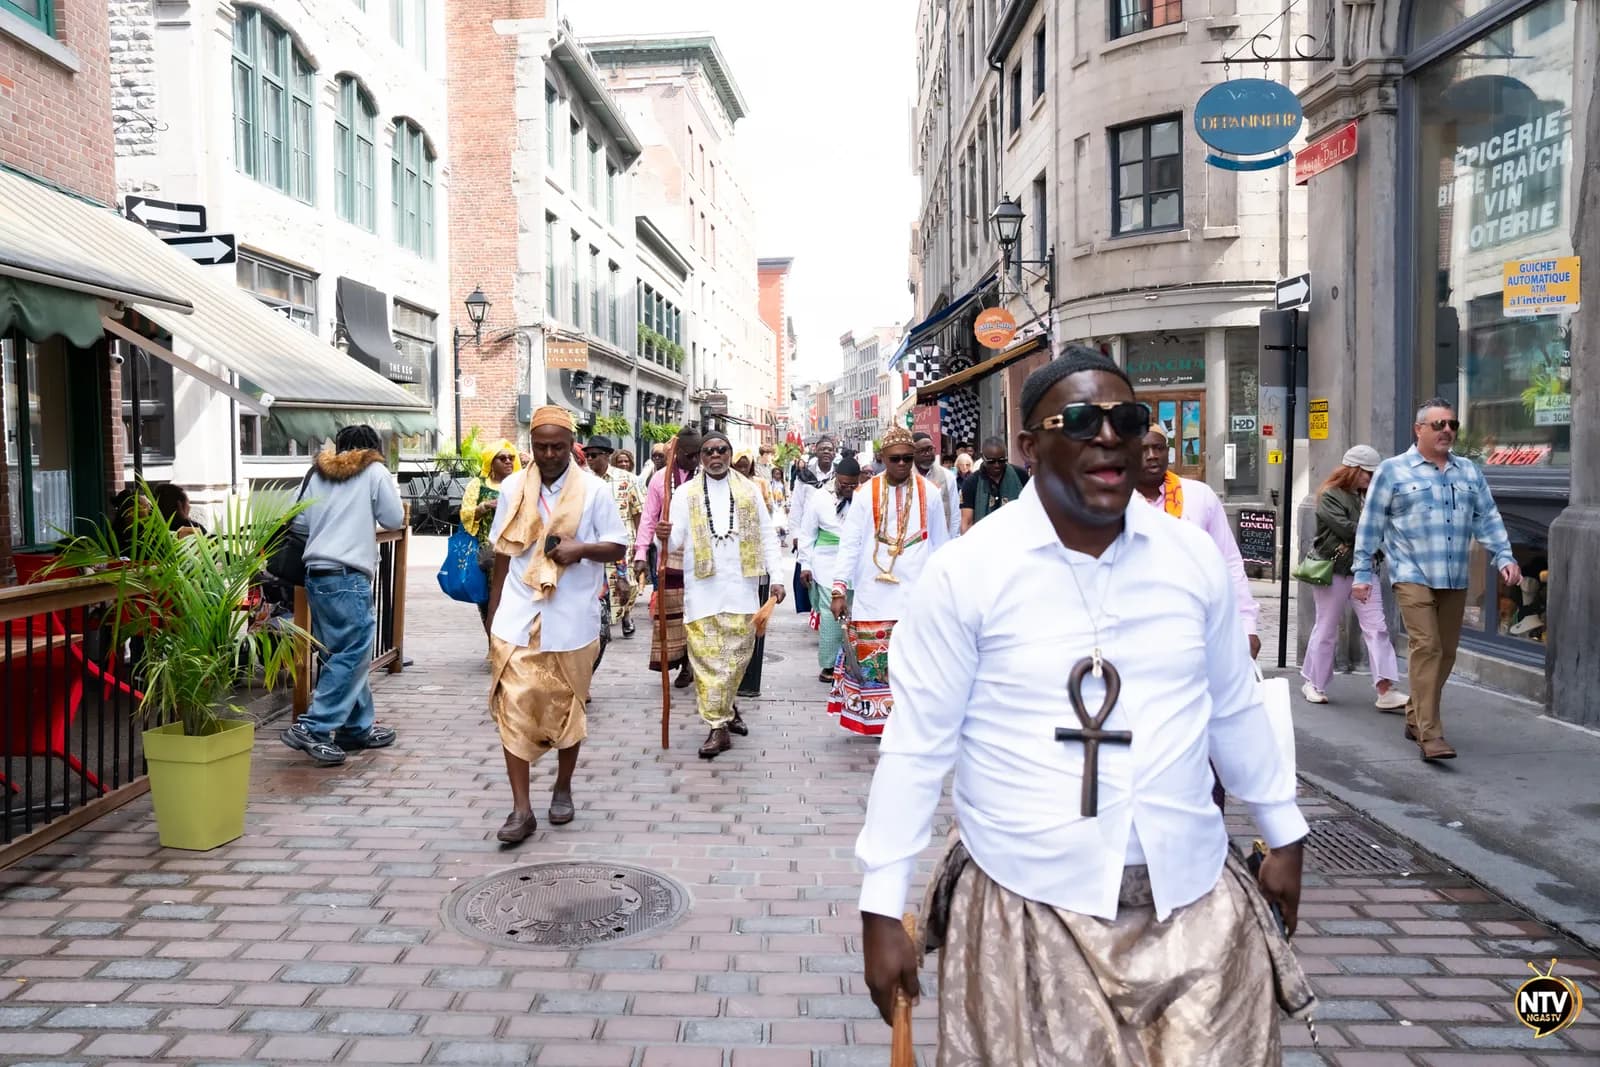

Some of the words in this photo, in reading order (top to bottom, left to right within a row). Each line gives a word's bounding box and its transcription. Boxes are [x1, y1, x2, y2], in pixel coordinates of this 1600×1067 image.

[1492, 138, 1572, 188] FRAÎCH
[1484, 182, 1524, 217] VIN
[1466, 201, 1556, 248] OTERIE
[1519, 260, 1557, 273] GUICHET
[1507, 271, 1571, 287] AUTOMATIQUE
[1530, 284, 1546, 293] ATM
[1233, 419, 1255, 430] H2D
